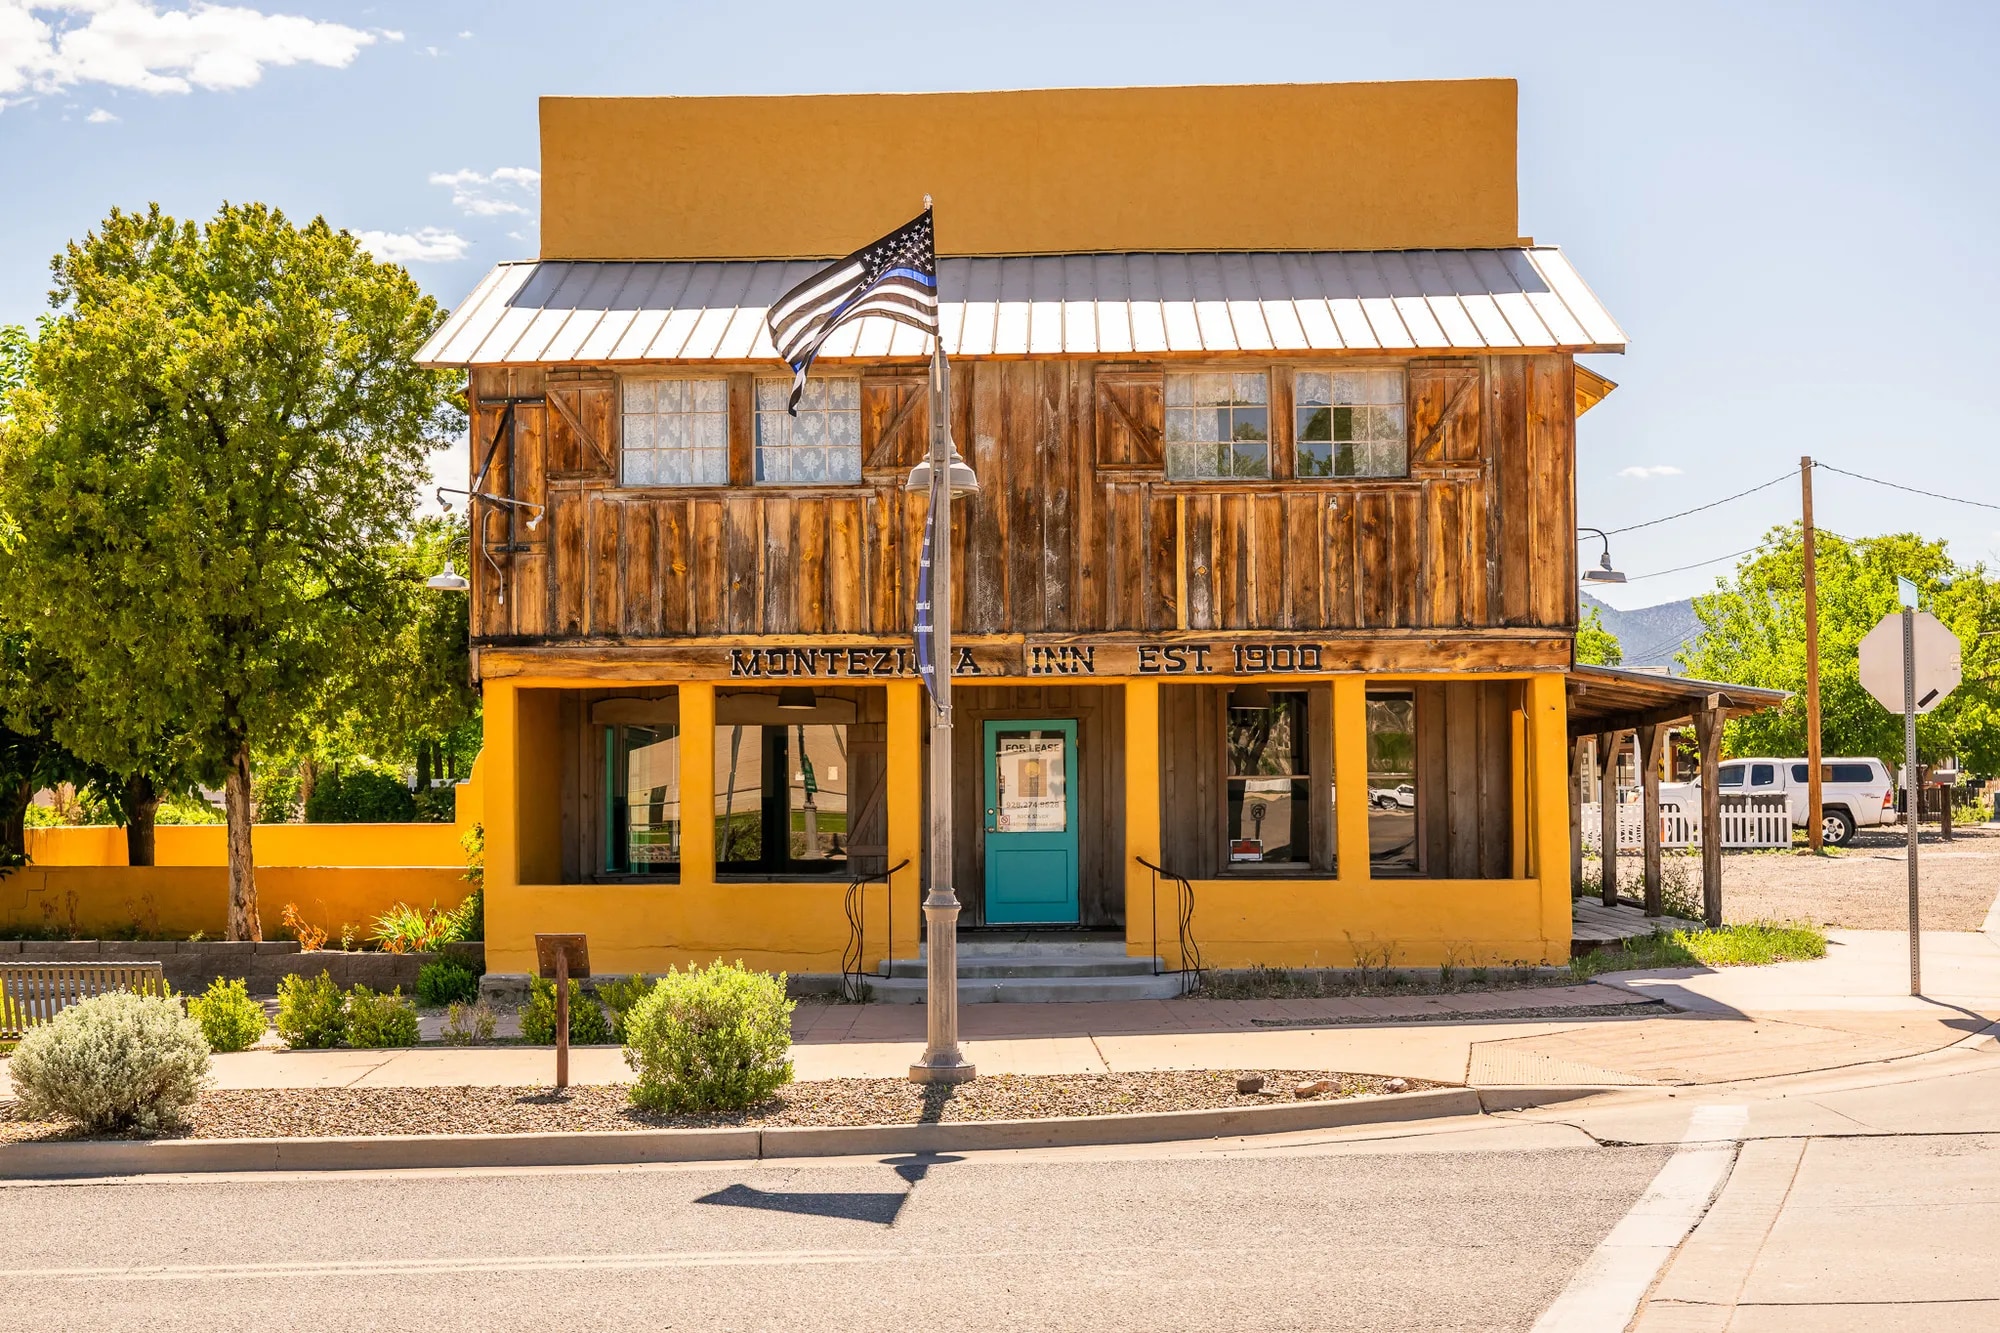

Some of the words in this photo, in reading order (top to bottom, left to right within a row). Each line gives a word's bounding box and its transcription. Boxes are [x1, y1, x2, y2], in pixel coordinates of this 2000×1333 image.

[730, 647, 981, 677] MONTEZUA
[1030, 646, 1095, 674] INN
[1137, 644, 1213, 673] EST.
[1232, 643, 1324, 673] 1900
[1005, 743, 1027, 752] FOR
[1028, 743, 1060, 752] LEASE
